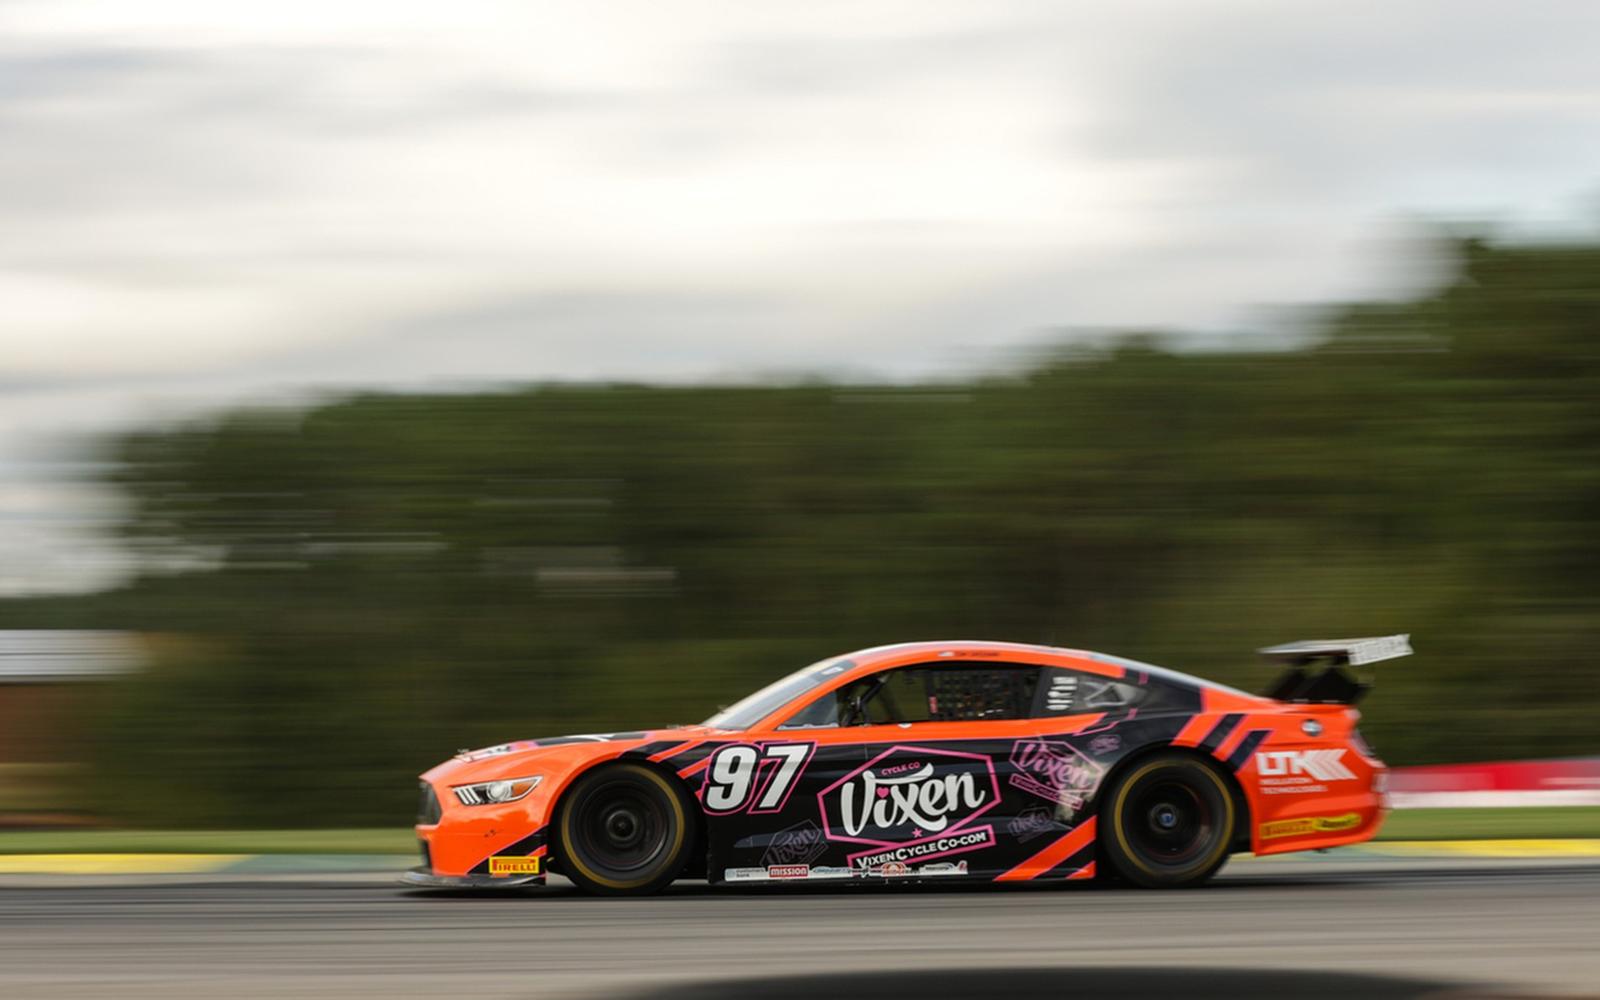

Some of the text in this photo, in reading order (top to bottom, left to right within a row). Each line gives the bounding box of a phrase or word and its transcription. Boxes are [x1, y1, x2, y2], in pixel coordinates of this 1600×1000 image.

[705, 743, 810, 811] 97
[881, 761, 921, 776] CYCLE CO
[840, 762, 985, 836] Vixen
[493, 858, 537, 872] PIRELLI
